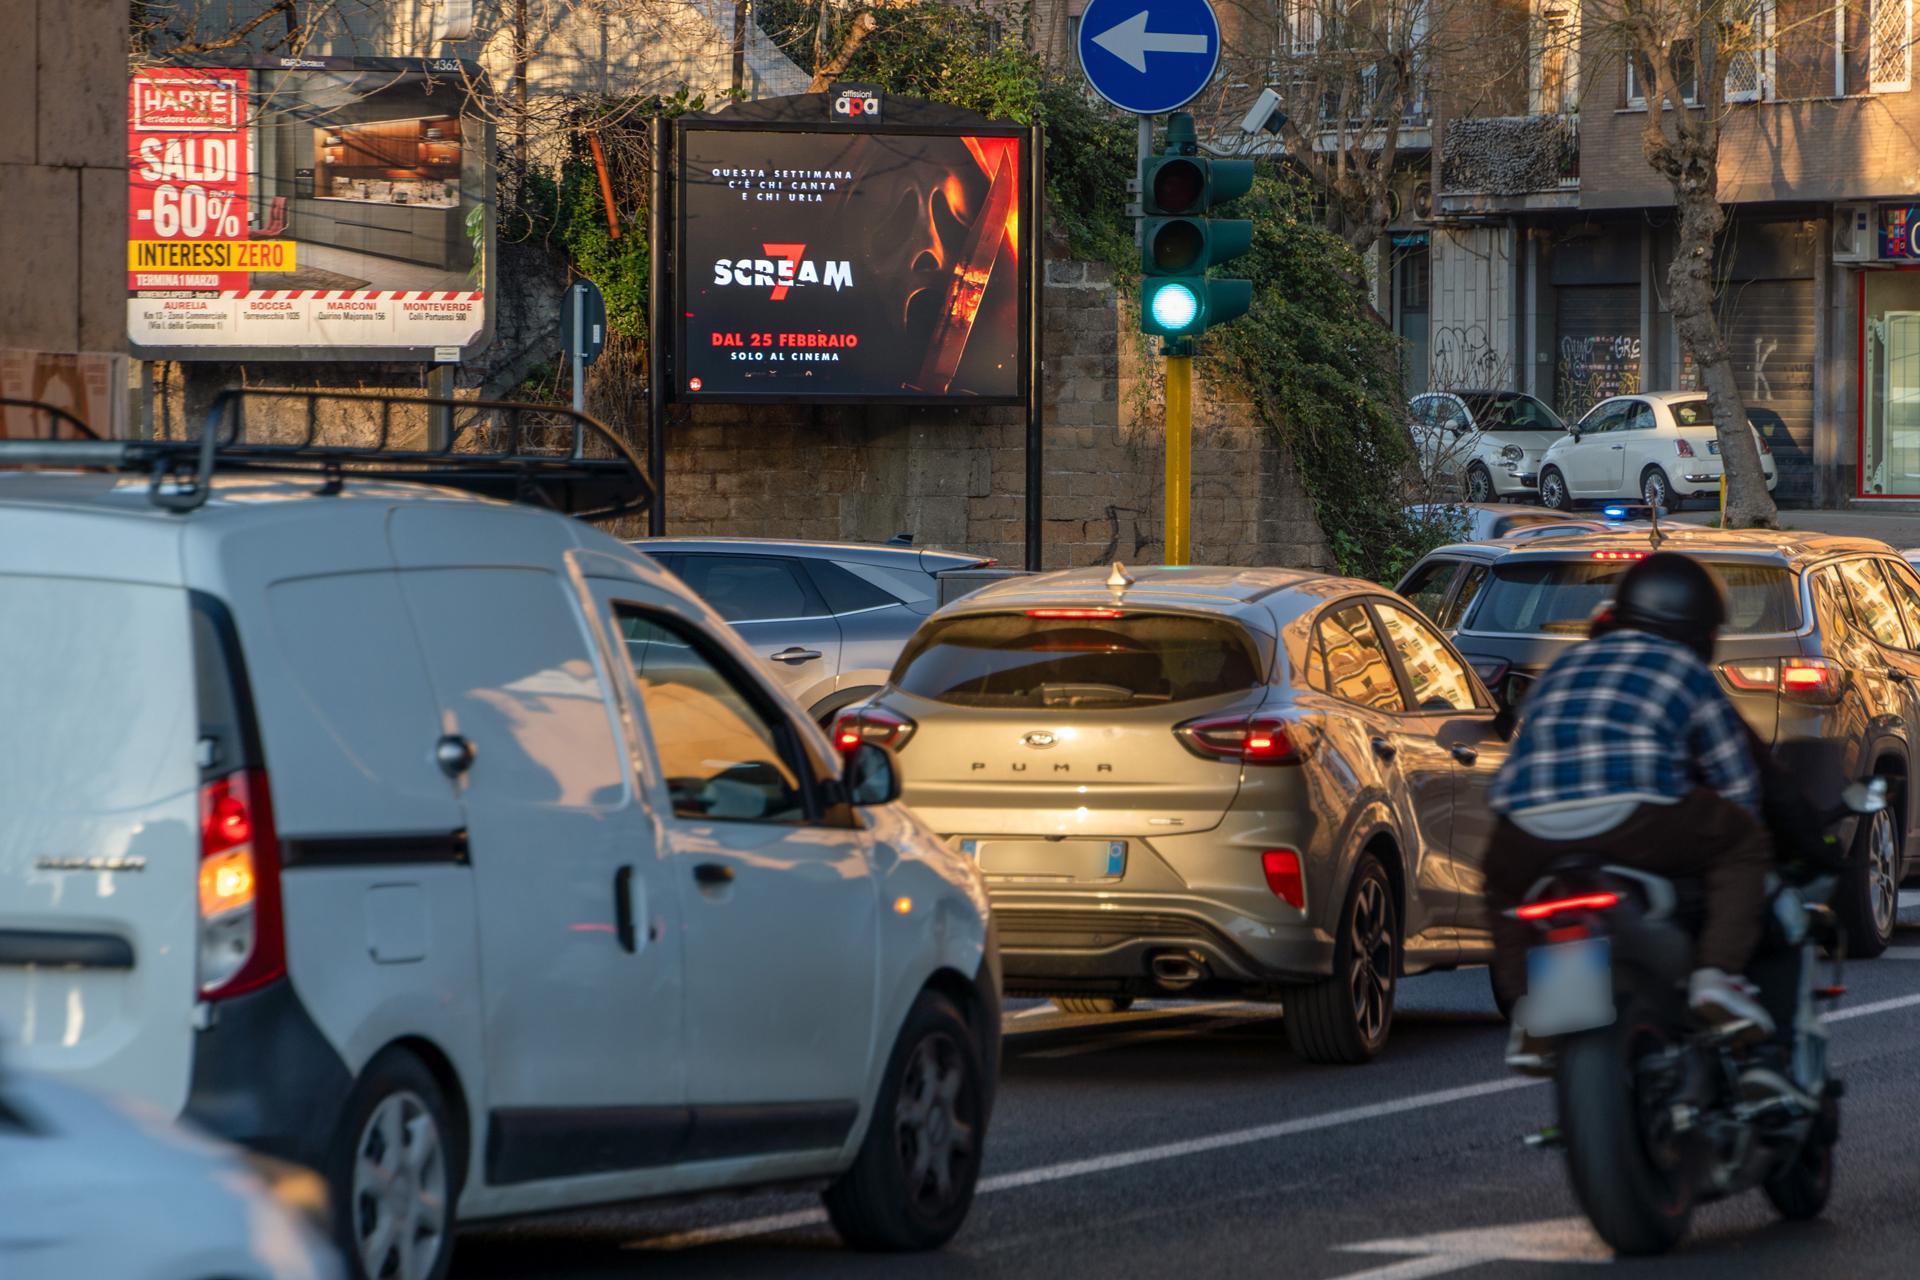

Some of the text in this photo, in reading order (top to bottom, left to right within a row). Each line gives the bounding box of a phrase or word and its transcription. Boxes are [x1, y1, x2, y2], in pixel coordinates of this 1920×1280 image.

[433, 59, 460, 71] 4362
[144, 90, 227, 112] HARTE
[835, 97, 879, 117] apa
[139, 137, 238, 182] SALDI
[712, 168, 853, 179] QUESTA SETTIMANA
[728, 179, 836, 190] C'È CHI CANTA
[741, 192, 823, 202] E CHI URLA
[137, 184, 240, 237] -60%
[138, 243, 284, 267] INTERESSI ZERO
[714, 258, 854, 292] SCREAM
[762, 243, 806, 300] 7
[136, 274, 219, 286] TERMINA 1 MARZO
[164, 302, 208, 310] AURELIA
[250, 302, 293, 310] BOCCEA
[403, 303, 473, 311] MONTEVERDE
[168, 312, 184, 320] Zona
[185, 312, 227, 320] Commerciale
[243, 312, 285, 320] Torrevecchia
[318, 312, 385, 321] Quirino Majorana 156
[409, 312, 424, 320] Colli
[425, 312, 454, 321] Portuensi
[168, 321, 184, 330] della
[185, 321, 216, 330] Giovanna
[711, 333, 858, 347] DAL 25 FEBBRAIO
[731, 352, 839, 361] SOLO AL CINEMA
[971, 762, 1112, 772] PUMA
